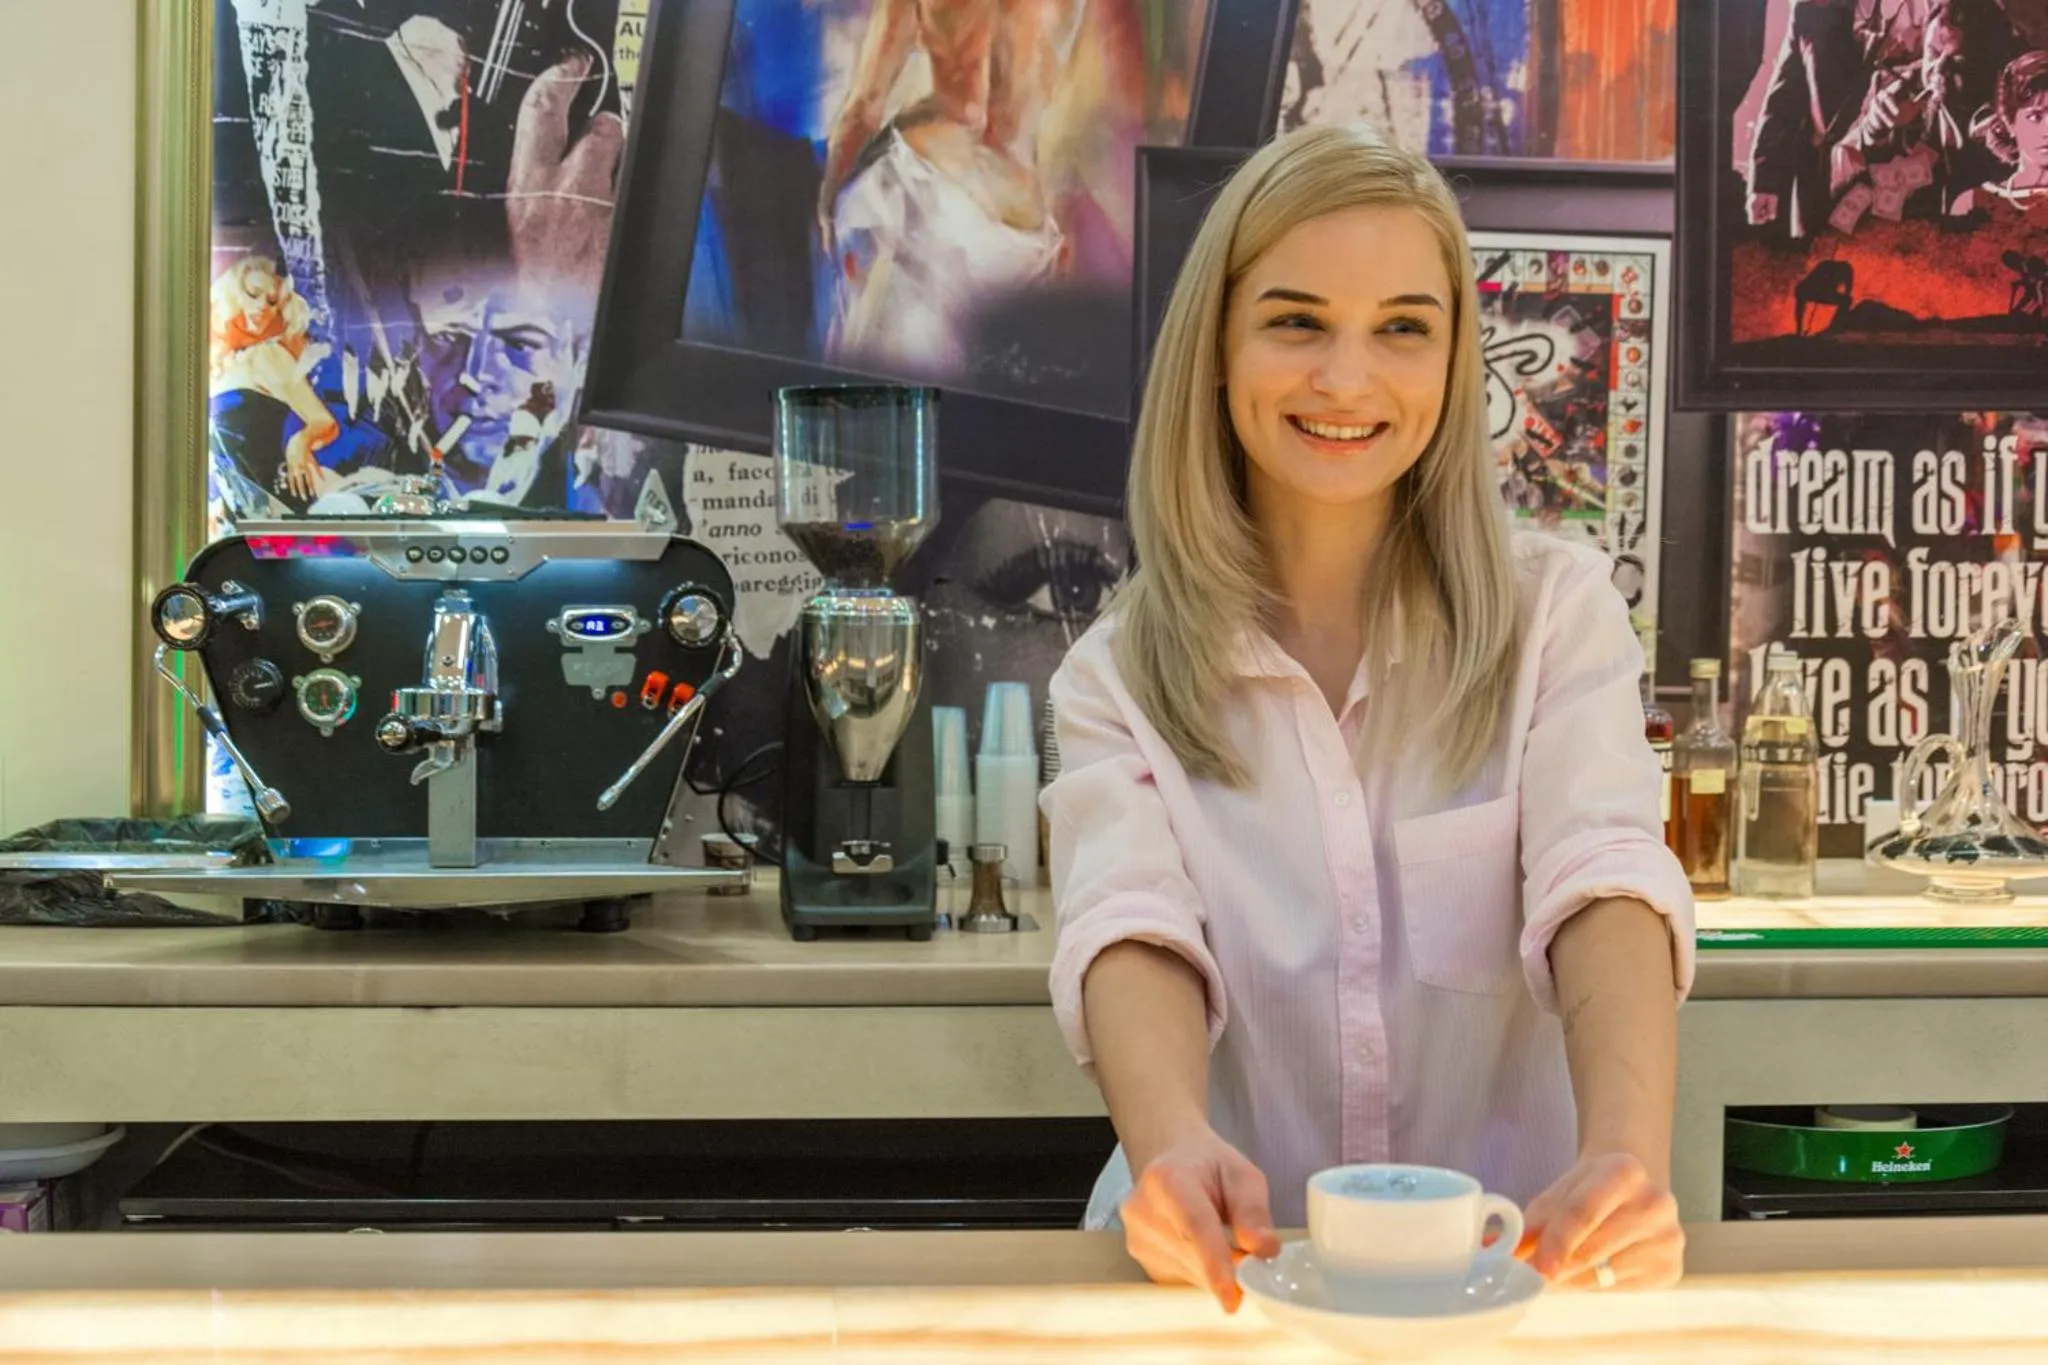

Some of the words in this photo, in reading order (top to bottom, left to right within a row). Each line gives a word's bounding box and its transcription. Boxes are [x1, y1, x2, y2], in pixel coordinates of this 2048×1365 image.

[1746, 431, 1897, 549] dream
[1912, 449, 1966, 536] as
[1981, 434, 2019, 535] if
[1789, 546, 1891, 639] live
[1868, 657, 1929, 747] as
[1871, 1160, 1931, 1173] Heineken
